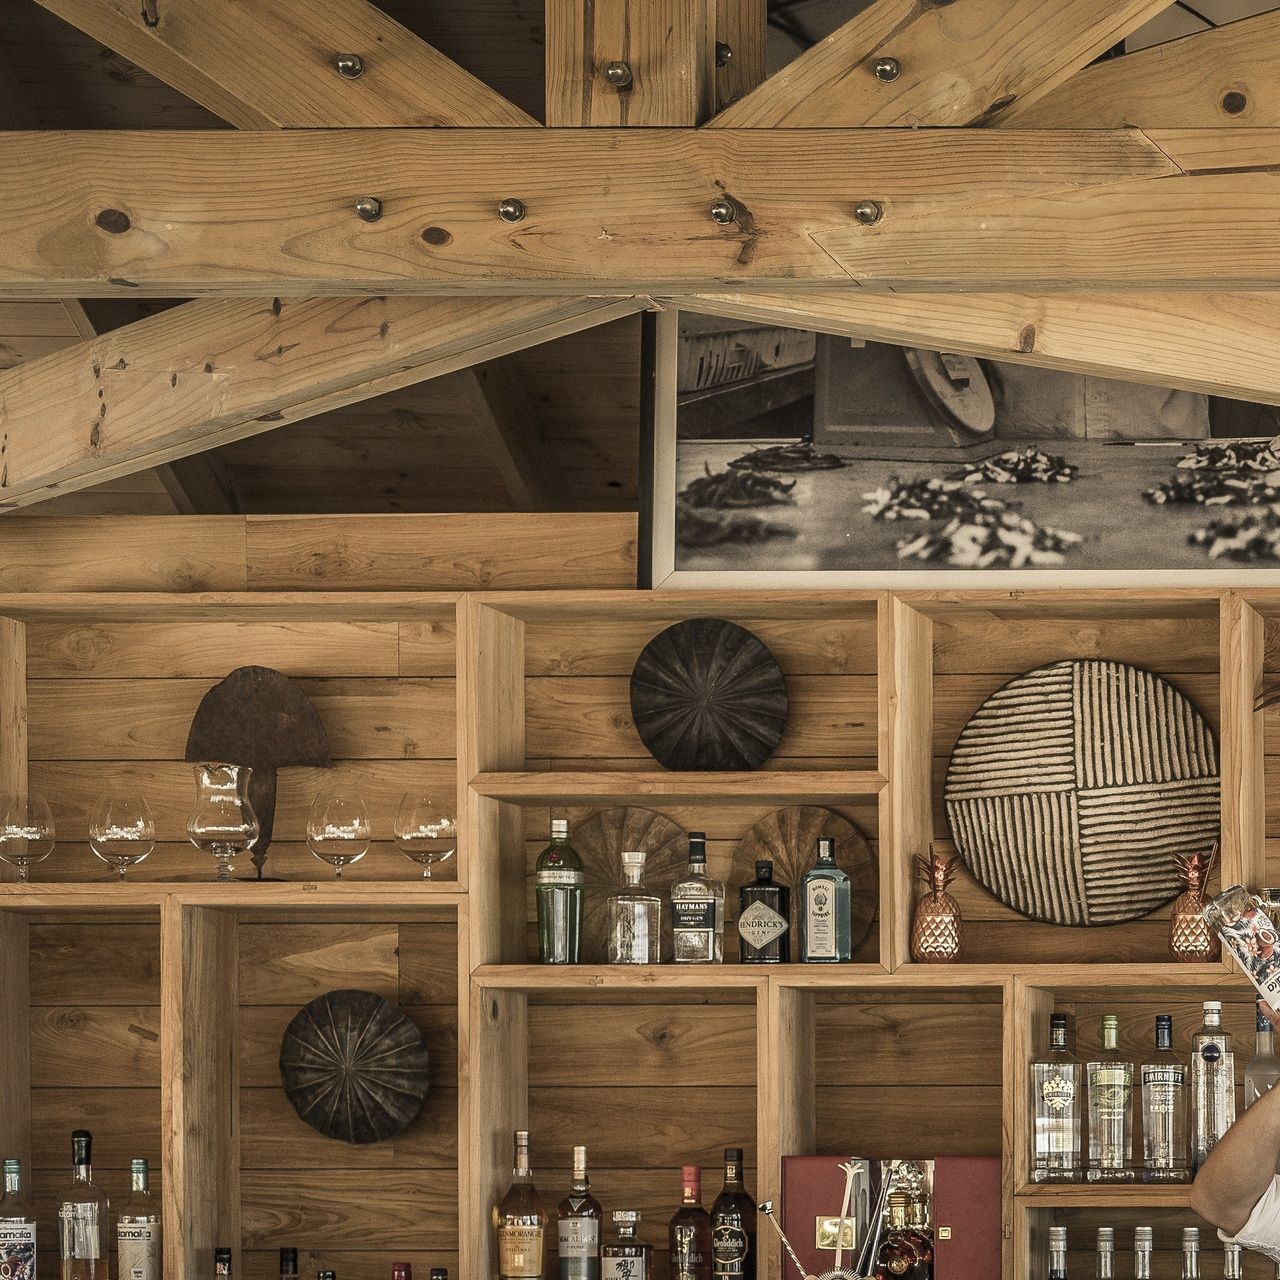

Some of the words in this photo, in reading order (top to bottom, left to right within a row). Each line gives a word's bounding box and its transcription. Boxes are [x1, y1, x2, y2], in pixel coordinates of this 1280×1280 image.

[1092, 1071, 1130, 1083] SMIRNOFF
[1144, 1071, 1182, 1082] SMIRNOFF
[713, 1238, 743, 1248] Glenfiddich
